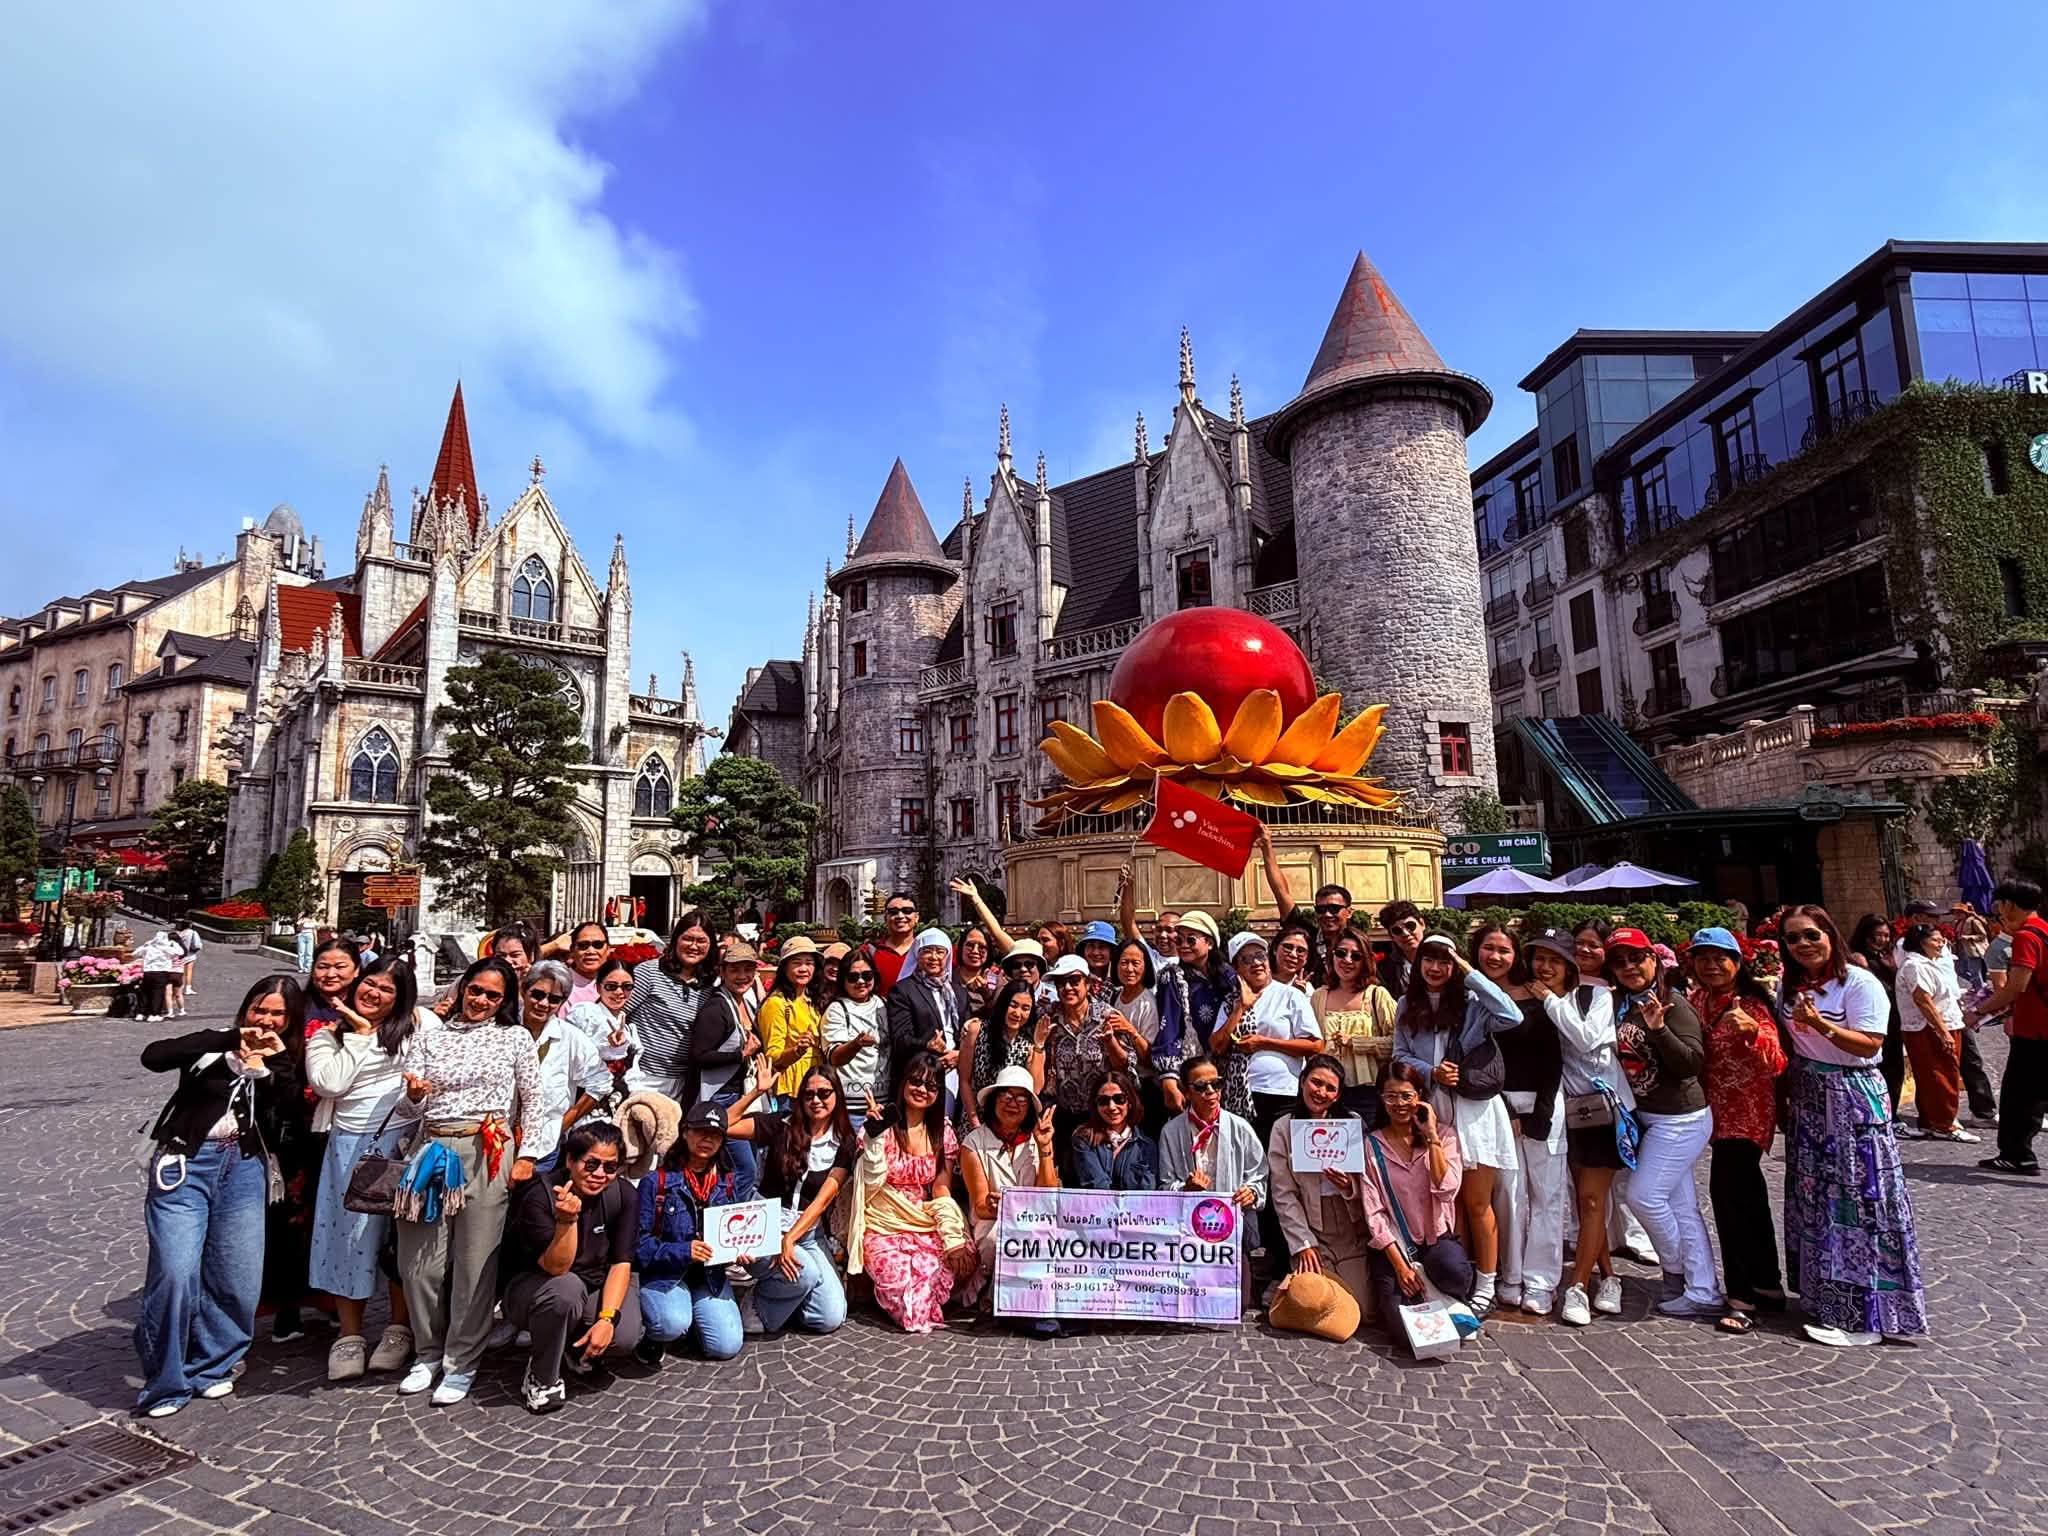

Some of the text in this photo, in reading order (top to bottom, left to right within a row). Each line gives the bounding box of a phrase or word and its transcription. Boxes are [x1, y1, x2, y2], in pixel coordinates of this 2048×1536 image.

[1441, 857, 1457, 866] AFE
[1465, 857, 1478, 865] ICE
[1481, 856, 1511, 864] CREAM
[1003, 1238, 1235, 1265] CM WONDER TOUR
[1046, 1263, 1071, 1274] Line
[1073, 1264, 1088, 1274] ID
